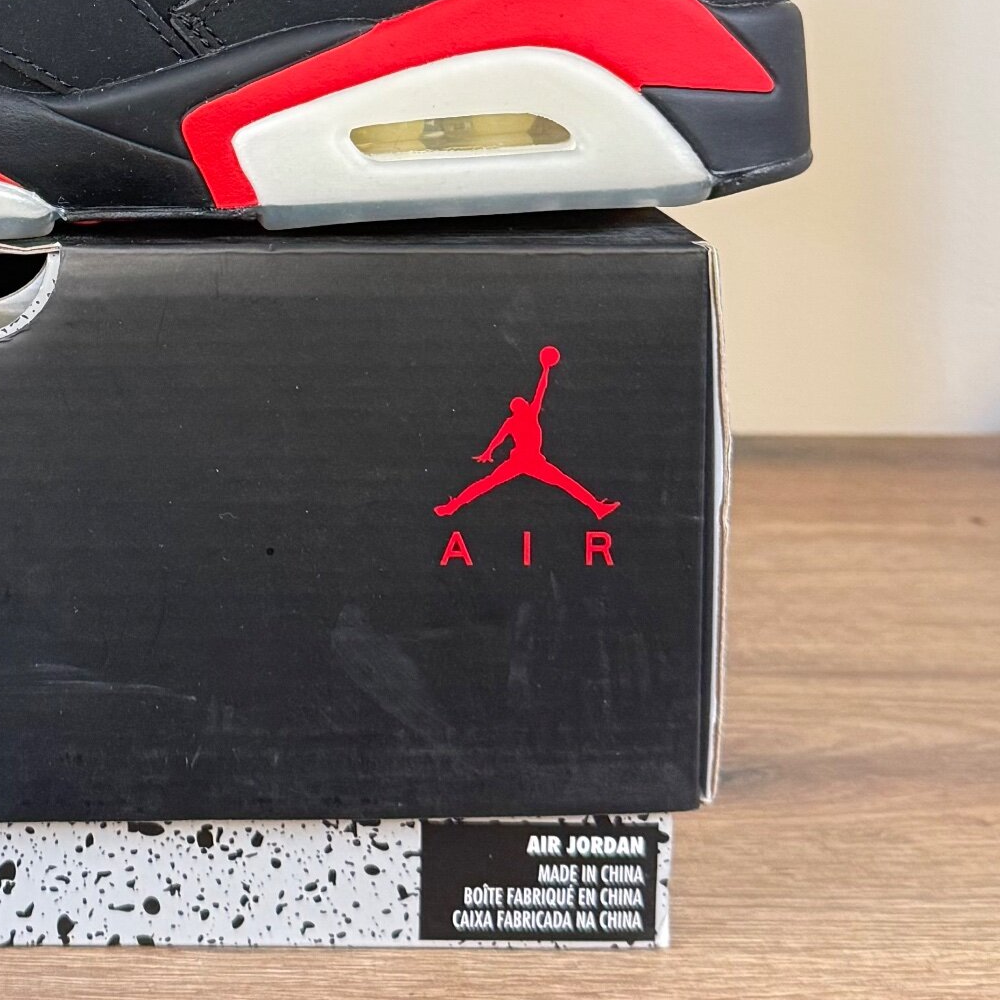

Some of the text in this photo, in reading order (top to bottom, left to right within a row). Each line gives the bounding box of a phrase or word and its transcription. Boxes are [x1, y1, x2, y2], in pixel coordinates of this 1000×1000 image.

[440, 531, 614, 566] AIR
[526, 835, 645, 856] AIR JORDAN
[538, 864, 645, 885] MADE IN CHINA
[464, 883, 644, 908] BOÎTE FABRIQUÉ EN CHINA
[452, 910, 644, 931] CAIXA FABRICADA NA CHINA
